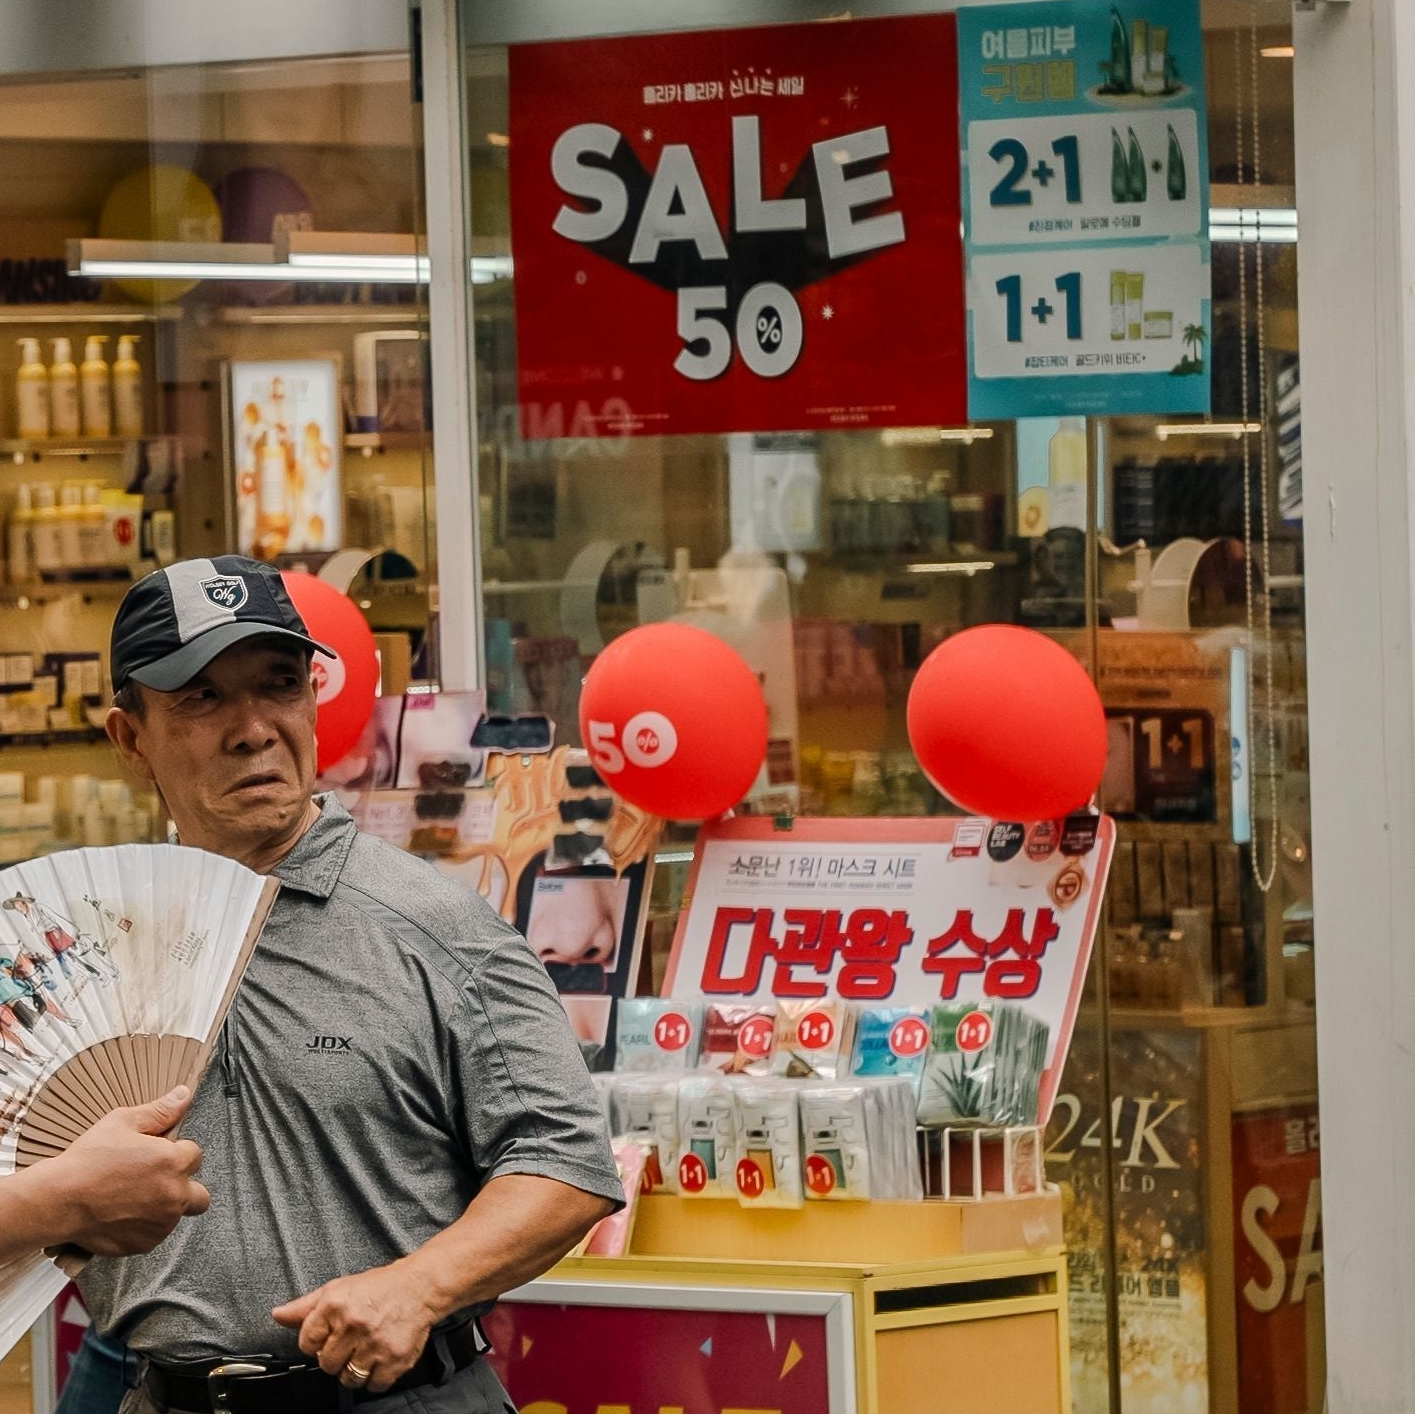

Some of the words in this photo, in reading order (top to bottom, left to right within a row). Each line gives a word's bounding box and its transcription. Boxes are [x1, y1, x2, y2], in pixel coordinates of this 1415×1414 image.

[981, 25, 1075, 59] 여름피부
[988, 134, 1083, 207] 2+1
[550, 115, 906, 263] SALE
[995, 272, 1083, 342] 1+1
[728, 855, 781, 878] 소문난
[788, 856, 822, 879] 1위!
[827, 857, 877, 879] 마스크
[884, 858, 917, 879] 시트
[701, 905, 915, 1001] 다관왕
[922, 906, 1061, 1001] 수상
[305, 1035, 354, 1051] JDX
[658, 1021, 687, 1045] 1+1
[744, 1025, 773, 1051] 1+1
[801, 1019, 831, 1043] 1+1
[894, 1026, 924, 1050] 1+1
[960, 1021, 987, 1044] 1+1
[1045, 1093, 1186, 1170] 24K
[681, 1163, 703, 1191] 1+1
[738, 1167, 760, 1191] 1+1
[806, 1167, 831, 1191] 1+1
